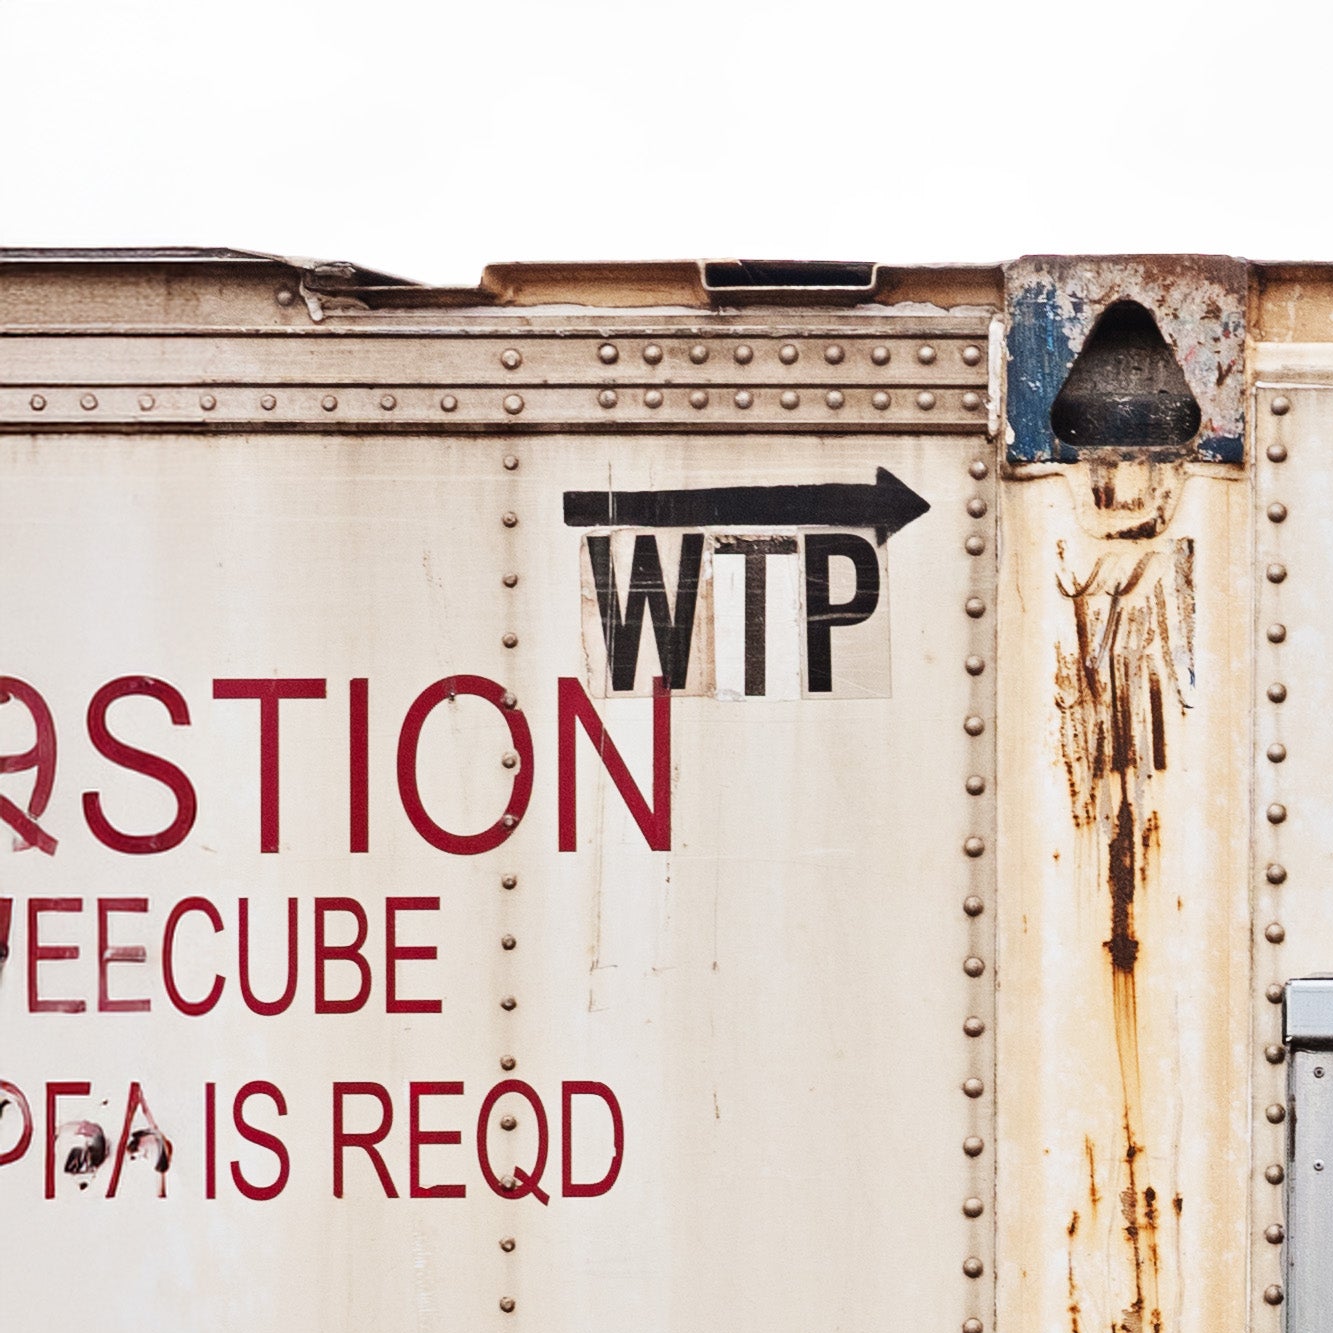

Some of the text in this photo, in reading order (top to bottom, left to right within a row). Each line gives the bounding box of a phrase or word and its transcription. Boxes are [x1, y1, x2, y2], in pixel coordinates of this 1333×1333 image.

[588, 533, 881, 697] WTP
[0, 897, 443, 1017] EECUBE
[206, 1080, 290, 1201] IS
[333, 1079, 624, 1206] REQD
